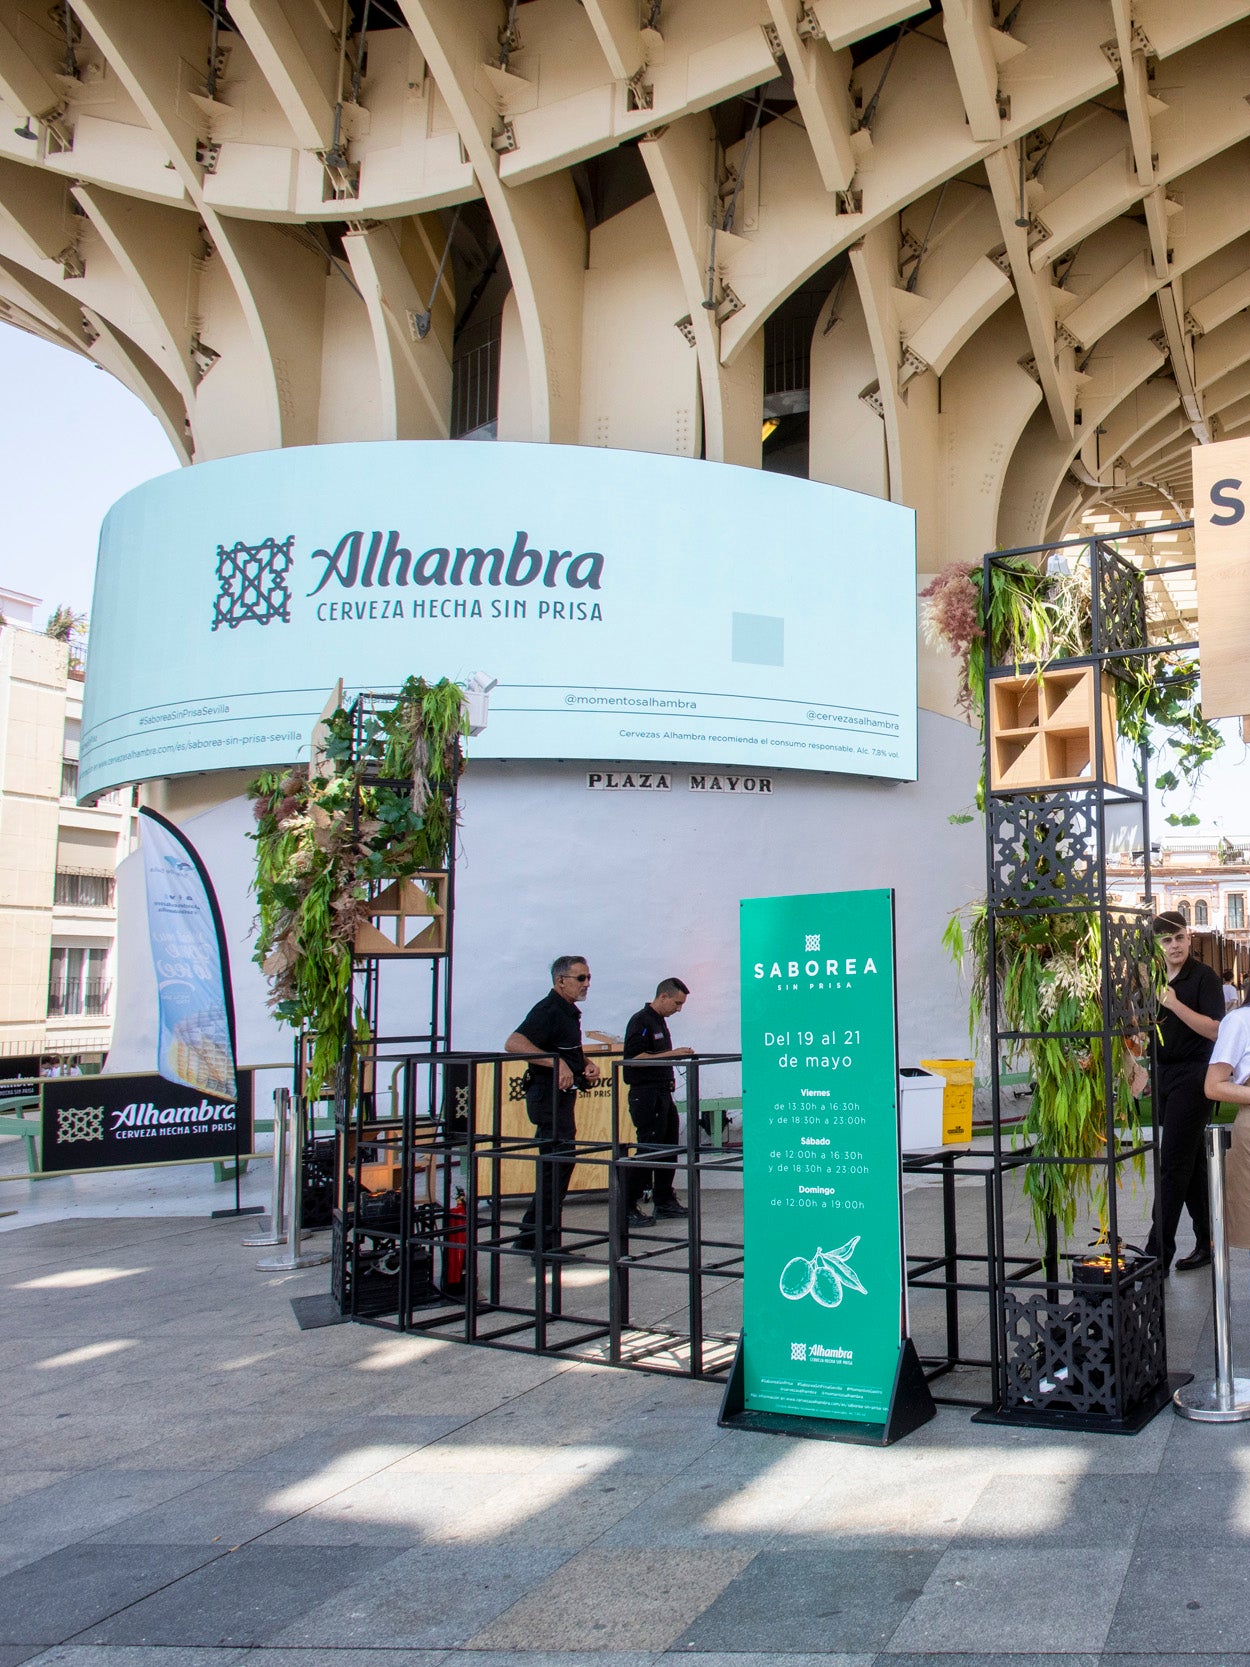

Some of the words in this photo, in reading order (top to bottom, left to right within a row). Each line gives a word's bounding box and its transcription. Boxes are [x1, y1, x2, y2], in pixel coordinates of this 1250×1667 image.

[306, 530, 604, 597] Alhambra
[317, 600, 404, 621] CERVEZA
[413, 599, 483, 618] HECHA
[491, 599, 527, 618] SIN
[538, 601, 603, 621] PRISA
[565, 694, 697, 709] @momentosalhambra
[139, 704, 230, 726] #SaboreaSinPrisaSevilla
[806, 710, 899, 730] @cervezasalhambra
[619, 729, 661, 739] Cervezas
[663, 731, 706, 741] Alhambra
[708, 735, 759, 745] recomienda
[770, 740, 807, 748] consumo
[588, 773, 670, 789] PLAZA
[690, 775, 772, 793] MAYOR
[754, 957, 877, 979] SABOREA
[777, 983, 798, 991] SIN
[809, 982, 852, 990] PRISA
[764, 1031, 790, 1046] Del
[797, 1031, 814, 1046] 19
[821, 1030, 836, 1045] al
[844, 1030, 860, 1045] 21
[778, 1054, 798, 1068] de
[805, 1055, 852, 1070] mayo
[800, 1089, 831, 1097] Viernes
[774, 1102, 785, 1110] de
[109, 1099, 236, 1131] Alhambra
[769, 1117, 774, 1125] y
[777, 1116, 788, 1124] de
[115, 1128, 157, 1139] CERVEZA
[159, 1126, 190, 1136] HECHA
[192, 1125, 208, 1133] SIN
[800, 1137, 831, 1145] Sábado
[770, 1150, 781, 1158] de
[768, 1165, 774, 1173] y
[777, 1163, 789, 1172] de
[798, 1185, 835, 1196] Domingo
[770, 1198, 782, 1206] de
[808, 1343, 853, 1359] Alhambra
